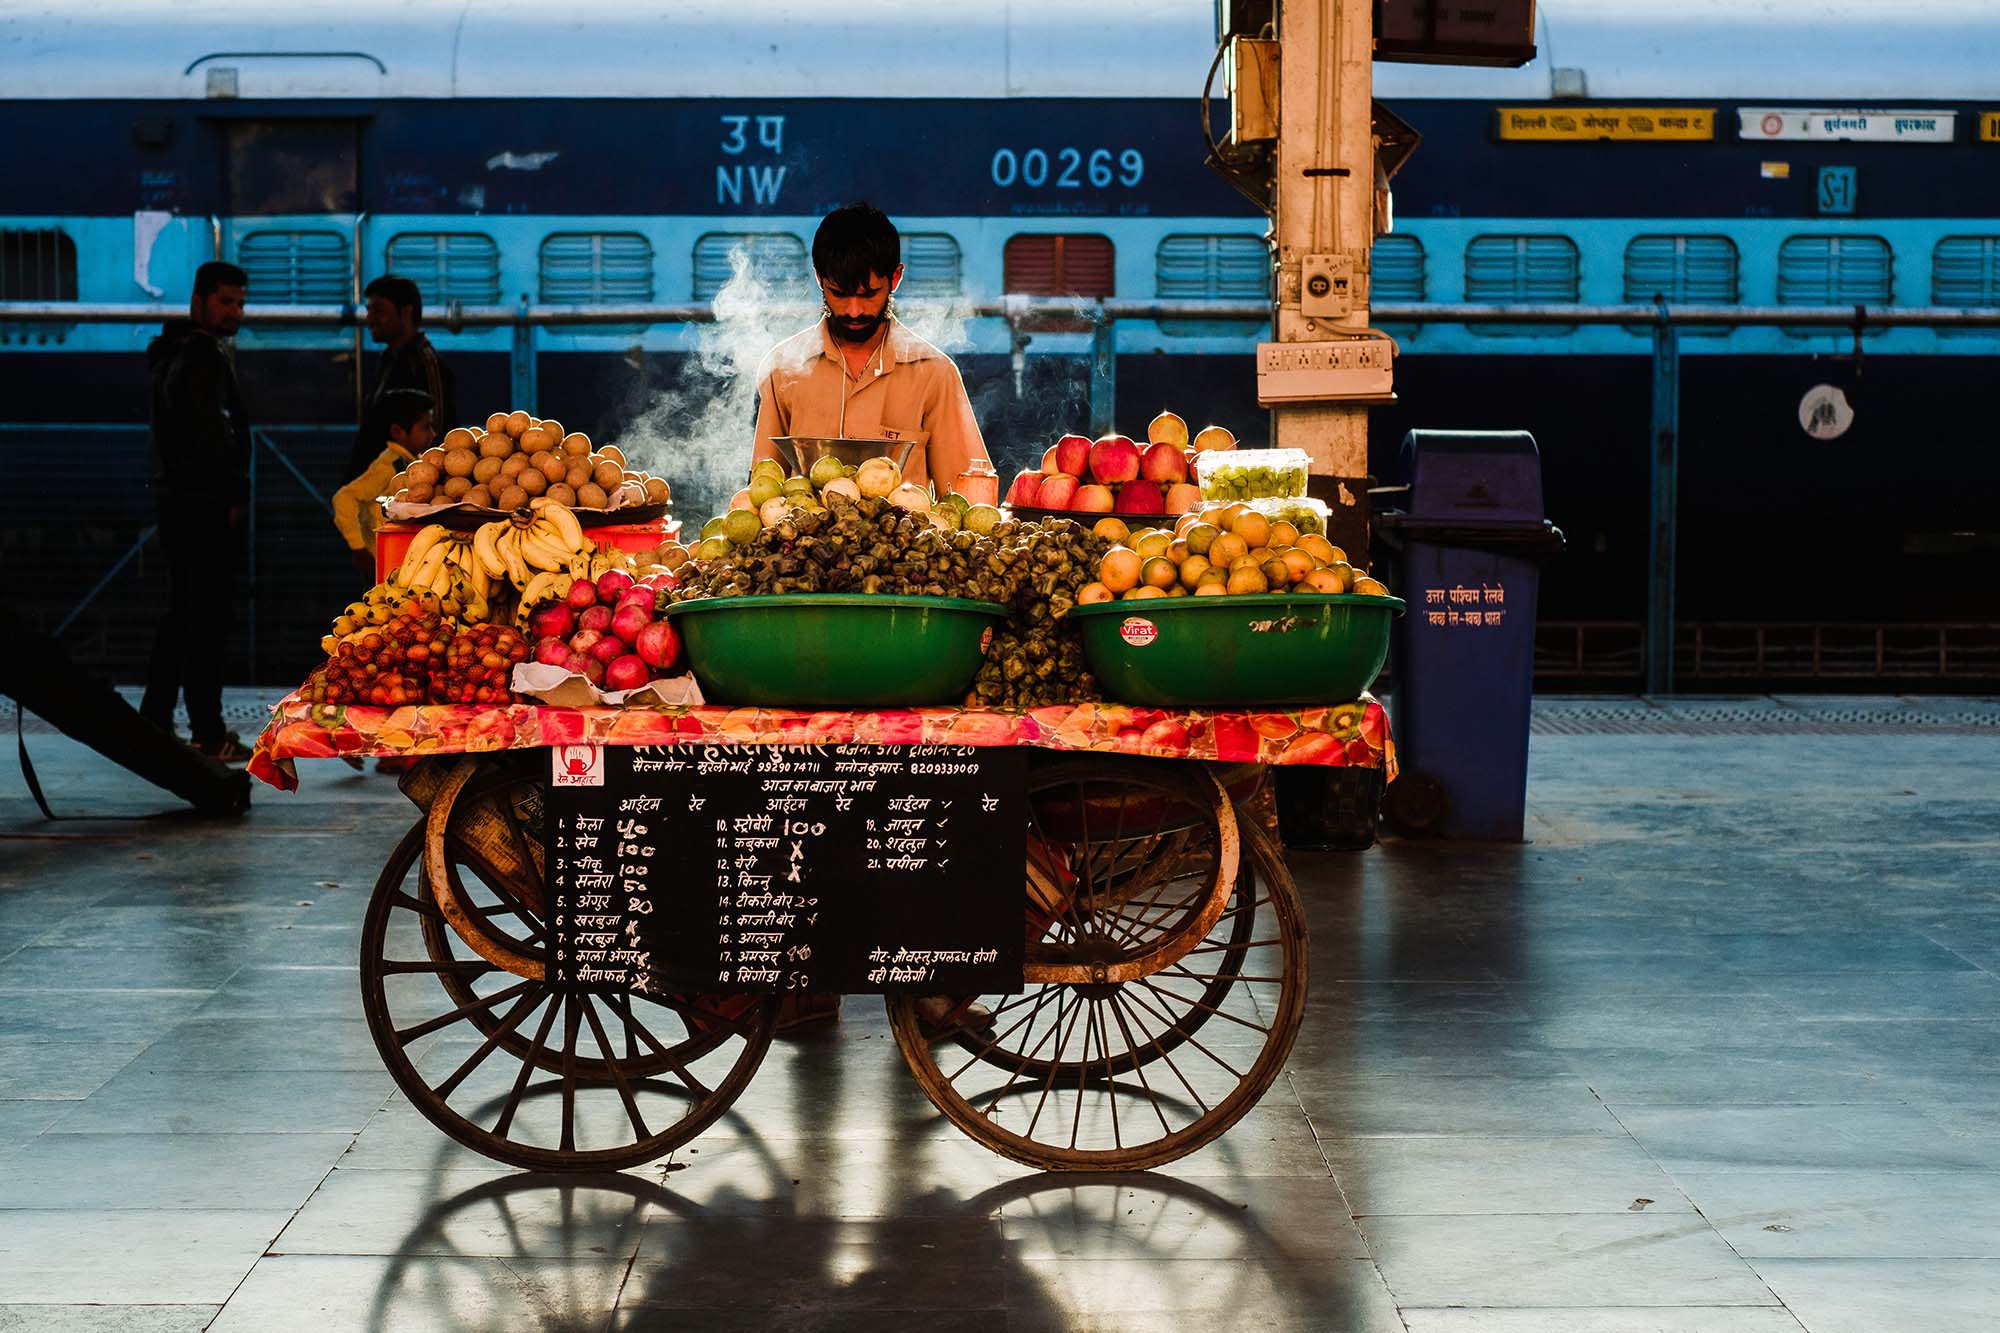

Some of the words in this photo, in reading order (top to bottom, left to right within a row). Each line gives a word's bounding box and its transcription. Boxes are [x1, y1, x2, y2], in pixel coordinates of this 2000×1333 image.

[990, 148, 1146, 188] 00269
[716, 165, 786, 205] NW
[1425, 589, 1445, 604] उत्तर
[1449, 584, 1480, 605] पश्चिम
[1483, 583, 1505, 604] रेलवे
[1123, 625, 1153, 635] Virat
[850, 779, 878, 792] भाव
[619, 794, 662, 814] आईटम
[689, 794, 706, 811] रेट
[766, 794, 808, 814] आईटम
[836, 793, 853, 811] रेट
[888, 795, 931, 812] आईटम
[982, 793, 999, 811] रेट
[576, 813, 604, 831] केला
[783, 818, 827, 836] 100
[884, 818, 926, 836] जामुन
[557, 836, 568, 847] 2.
[575, 833, 599, 850] सेव
[617, 841, 656, 857] 100
[866, 838, 882, 849] 20.
[556, 858, 568, 869] 3.
[619, 863, 648, 877] 100
[717, 859, 730, 870] 12.
[734, 854, 759, 870] चेरी
[867, 858, 881, 869] 21.
[886, 854, 928, 871] पपीता
[575, 874, 614, 889] सन्तरा
[623, 879, 648, 892] 50
[717, 875, 732, 887] 13.
[556, 895, 567, 907] 5.
[576, 950, 607, 962] काला
[719, 952, 733, 962] 17.
[973, 947, 998, 965] होगी
[718, 970, 730, 982] 18
